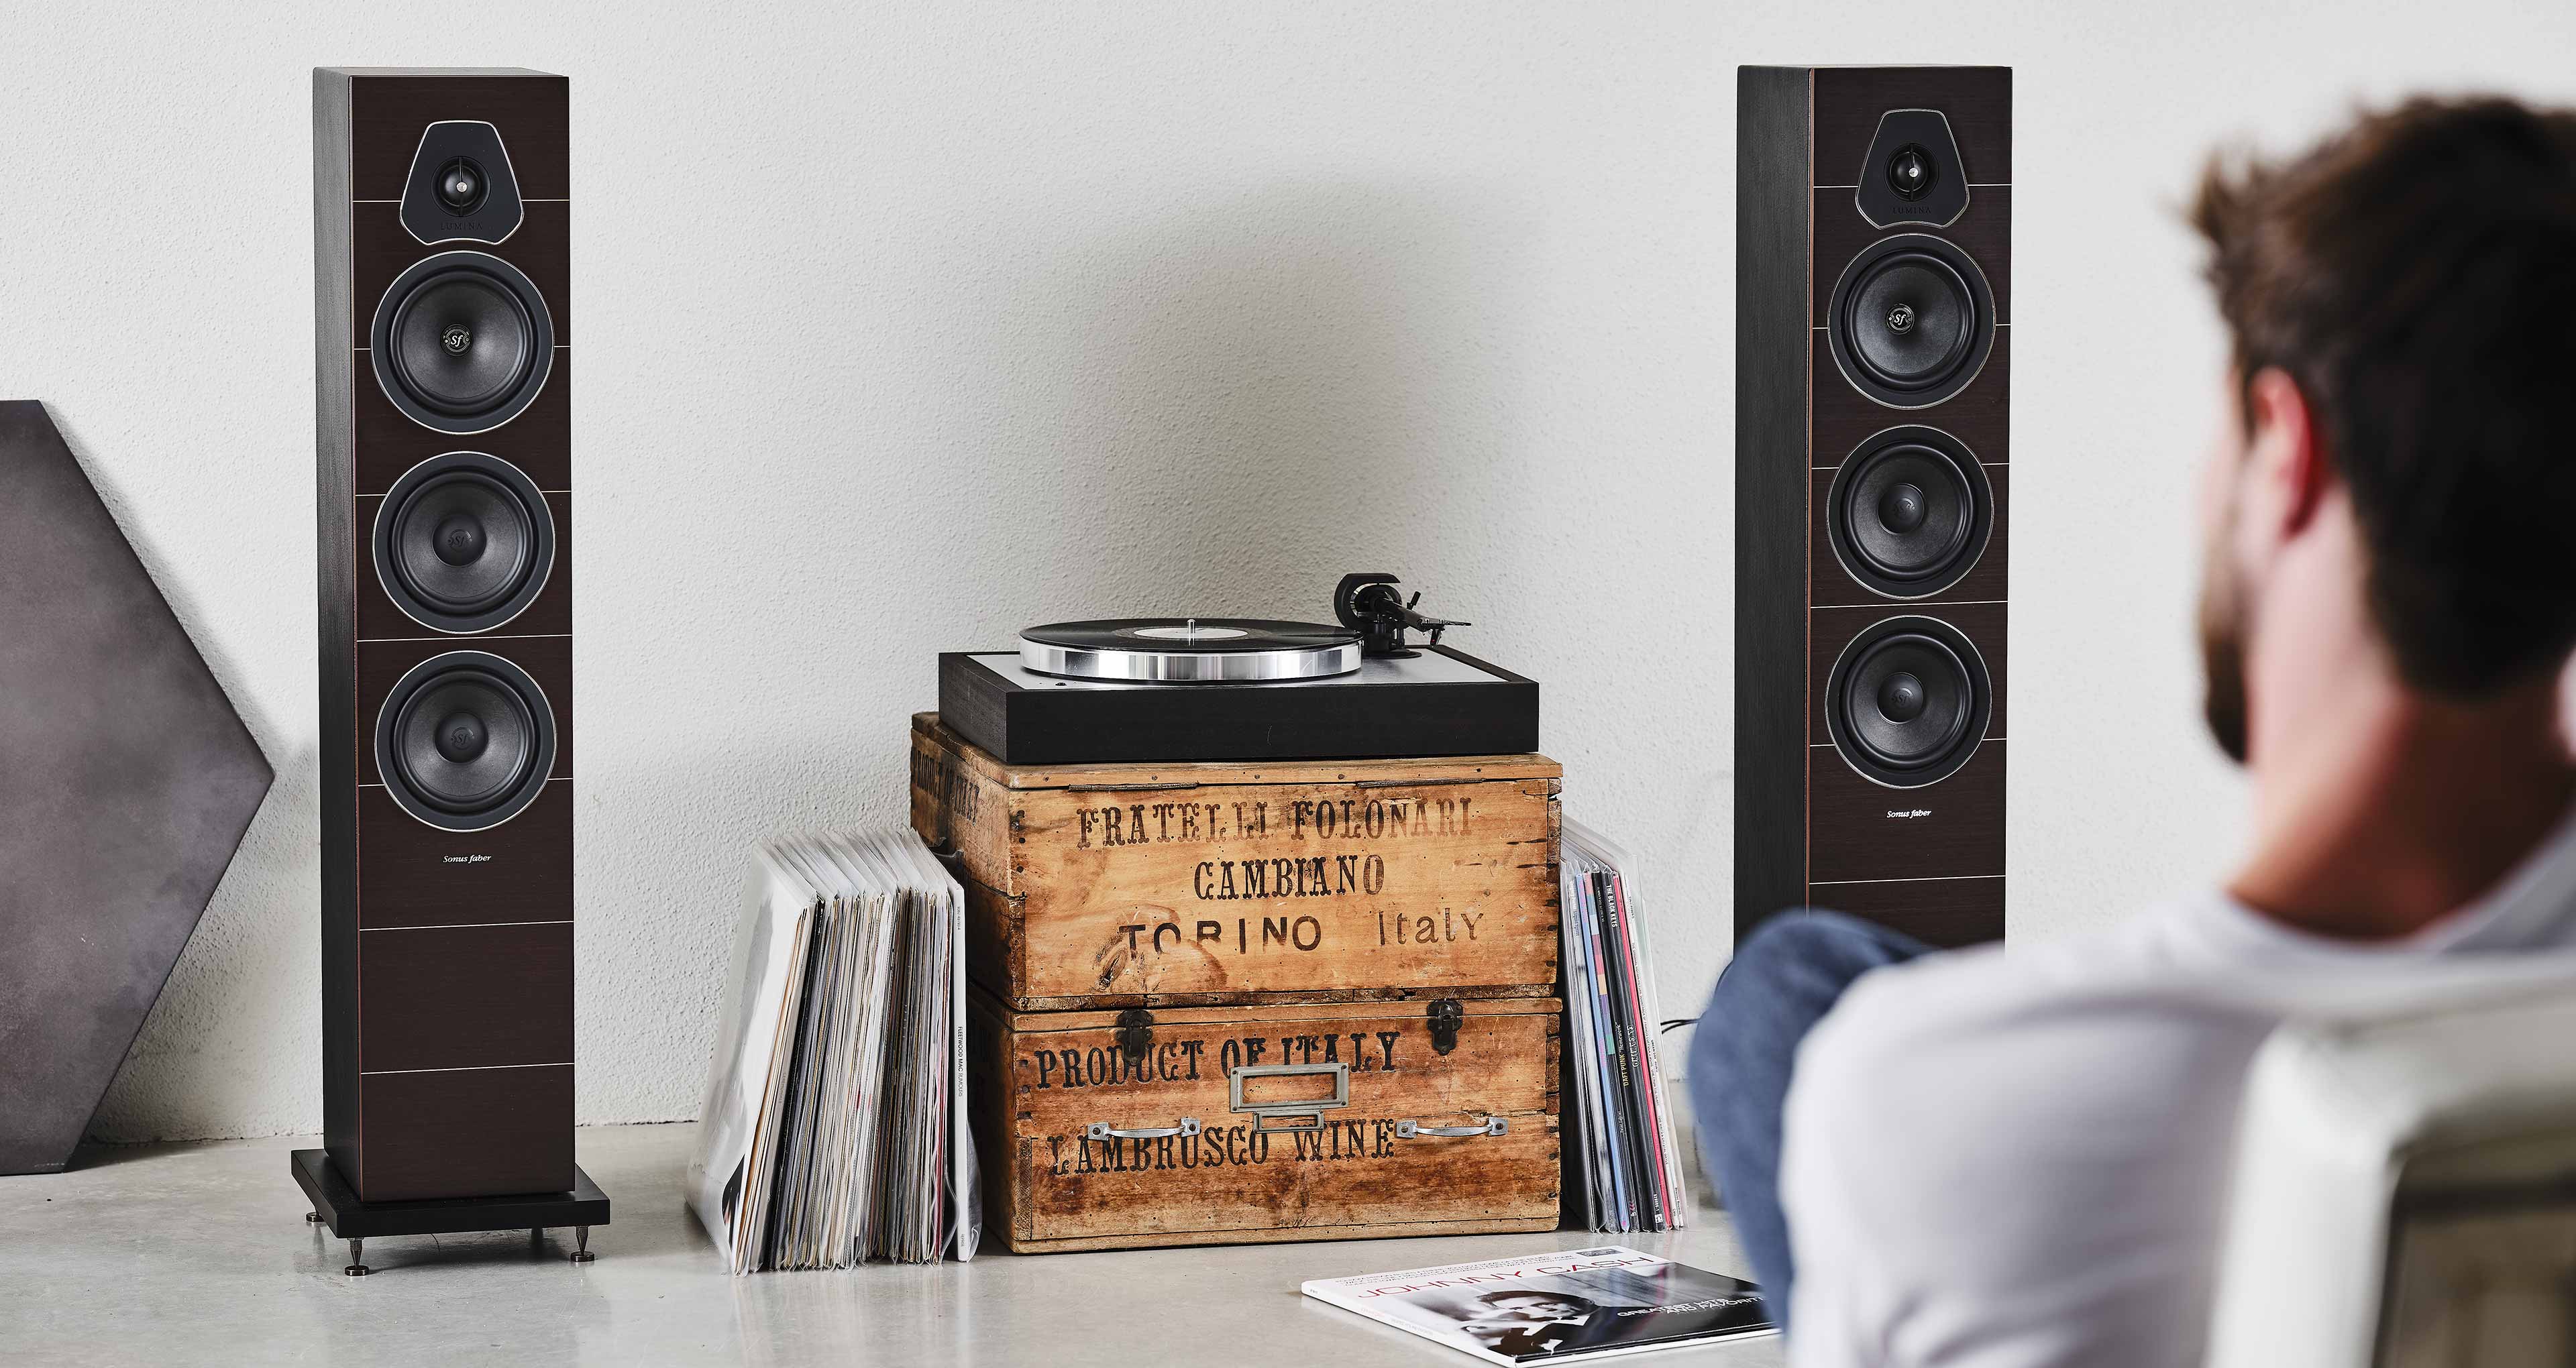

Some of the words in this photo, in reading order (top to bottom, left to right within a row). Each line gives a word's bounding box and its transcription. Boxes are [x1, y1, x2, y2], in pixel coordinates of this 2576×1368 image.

[1076, 801, 1268, 848] FRATELLI
[1291, 797, 1472, 840] FOLONARI
[1886, 810, 1910, 818] Sonus
[1909, 809, 1932, 819] faber
[443, 855, 468, 863] Sonus
[468, 854, 492, 864] faber
[1194, 854, 1384, 900] CAMBIANO
[1607, 895, 1615, 913] BLACK
[1119, 916, 1322, 956] TORINO
[1627, 1024, 1634, 1035] EL
[1034, 1039, 1205, 1089] PRODUCT
[1220, 1037, 1266, 1079] OF
[1281, 1031, 1401, 1074] ITALY
[1628, 1036, 1640, 1068] CAMINO
[1619, 1053, 1627, 1072] PUNK
[1621, 1072, 1629, 1086] DAFT
[1047, 1125, 1269, 1176] LAMBRUSCO
[1289, 1118, 1395, 1161] WINE
[1358, 1271, 1523, 1298] JOHNNY
[1536, 1257, 1654, 1275] CASH
[1617, 1302, 1692, 1316] GREATEST
[1693, 1298, 1729, 1307] HITS
[1666, 1306, 1698, 1315] AND
